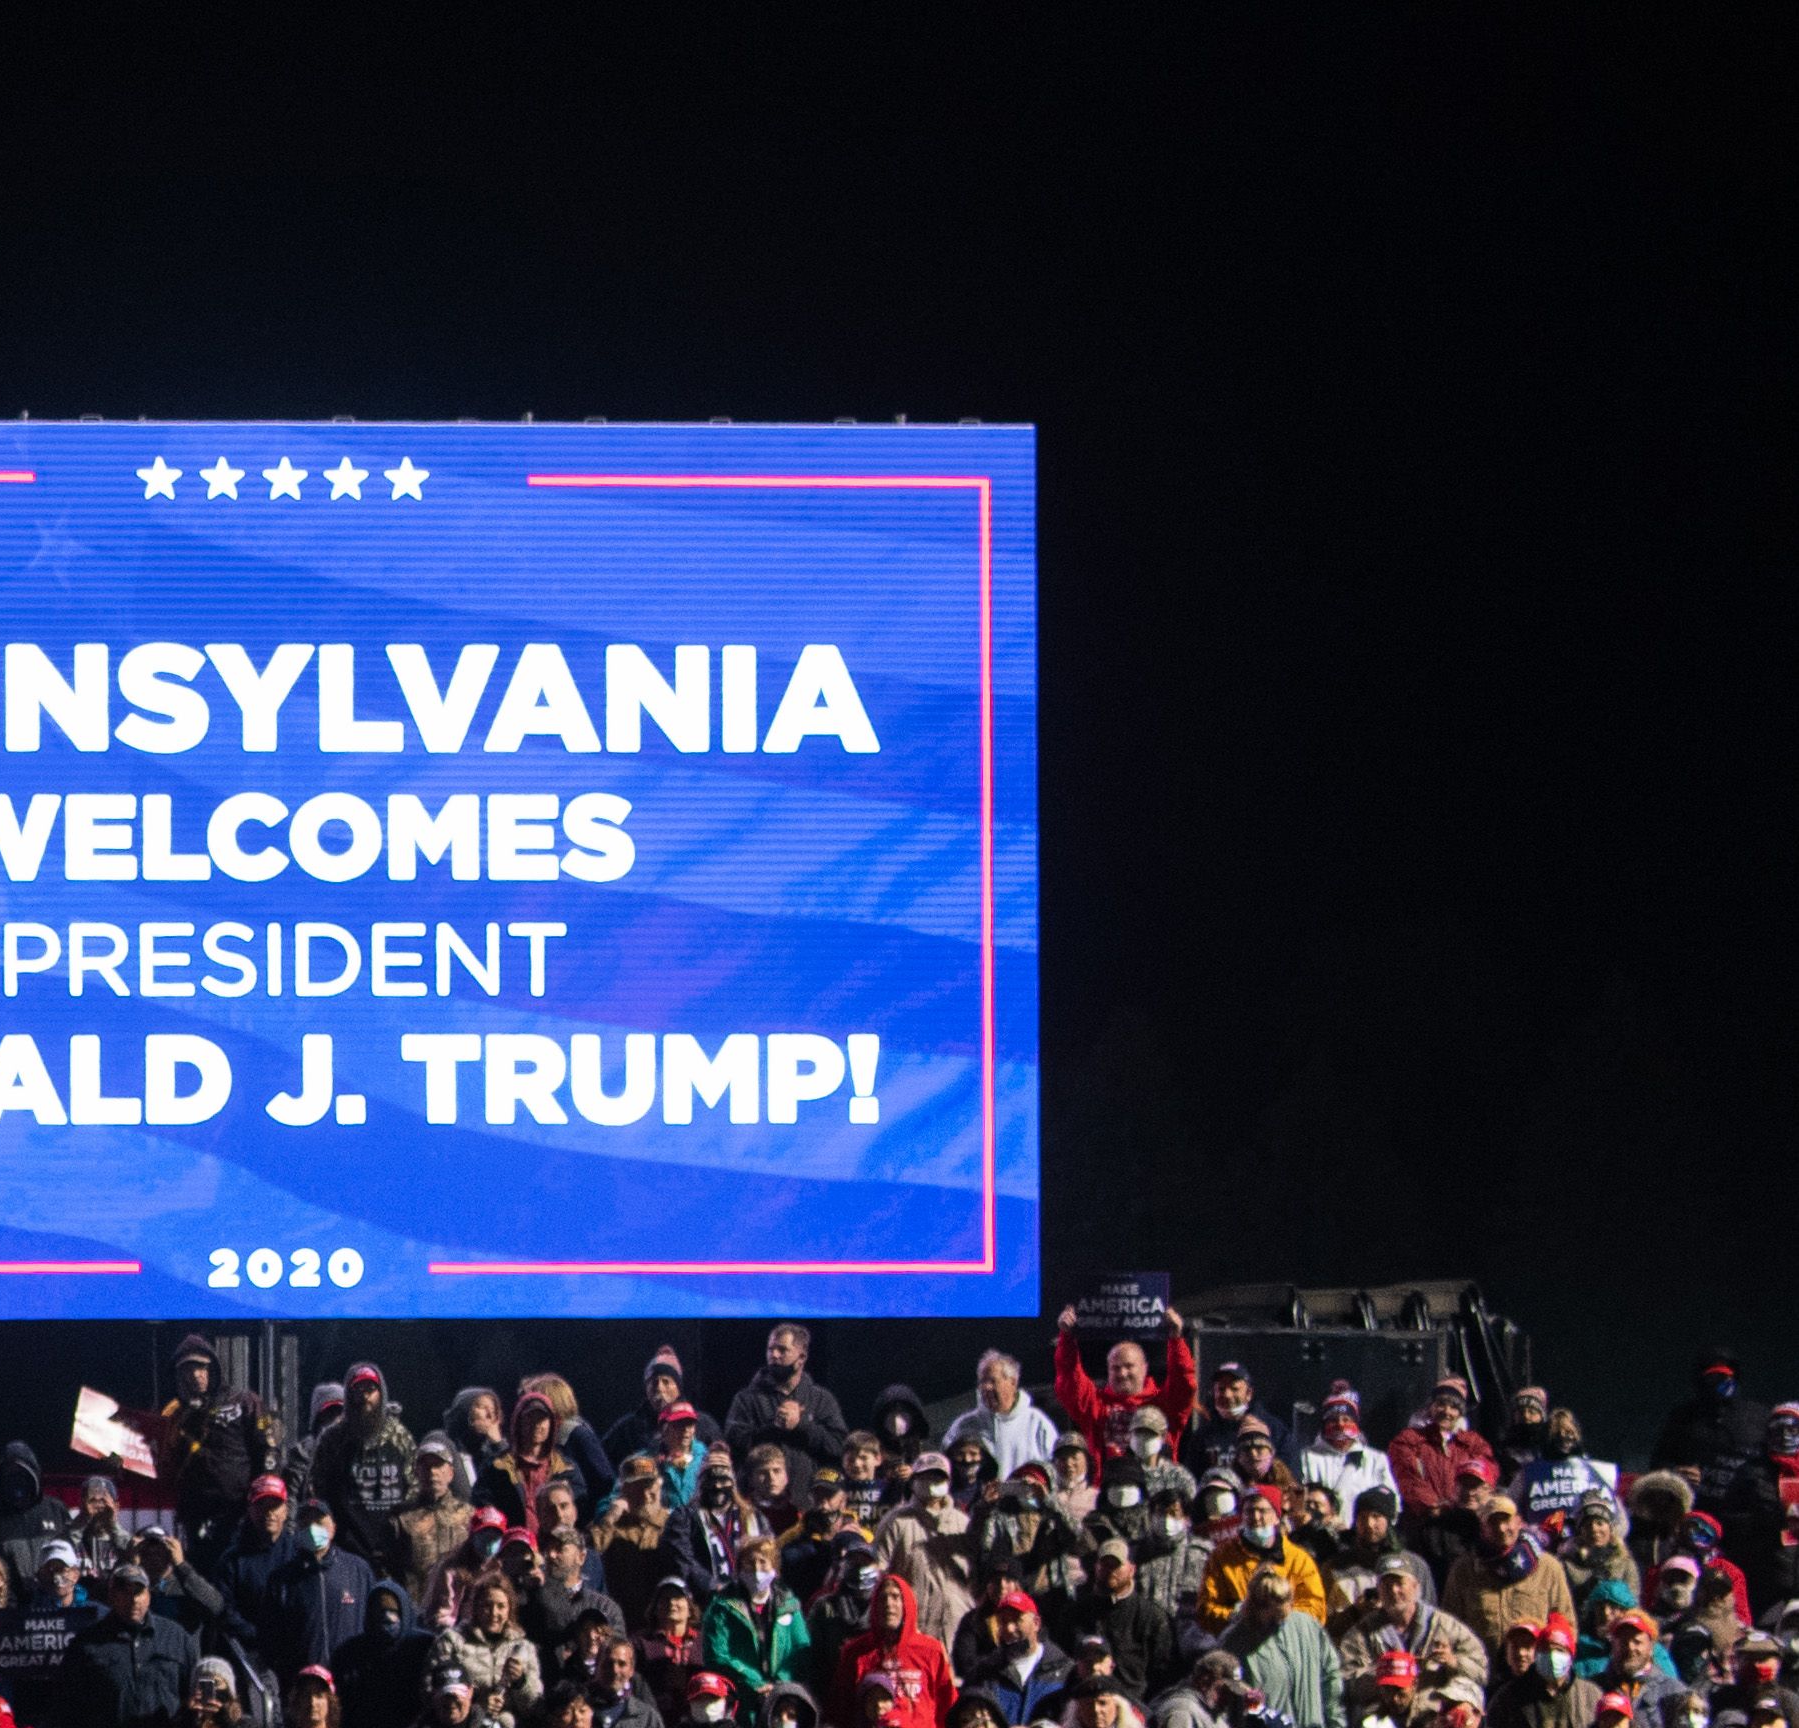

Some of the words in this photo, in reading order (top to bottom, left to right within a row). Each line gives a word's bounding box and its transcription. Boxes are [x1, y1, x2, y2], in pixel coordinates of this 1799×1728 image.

[3, 920, 568, 998] PRESIDENT
[265, 1034, 367, 1127] J.
[400, 1033, 881, 1127] TRUMP!
[208, 1247, 365, 1289] 2020
[1078, 1298, 1165, 1313] AMERICA
[24, 1618, 66, 1631] MAKE
[1, 1633, 77, 1651] AMERIC
